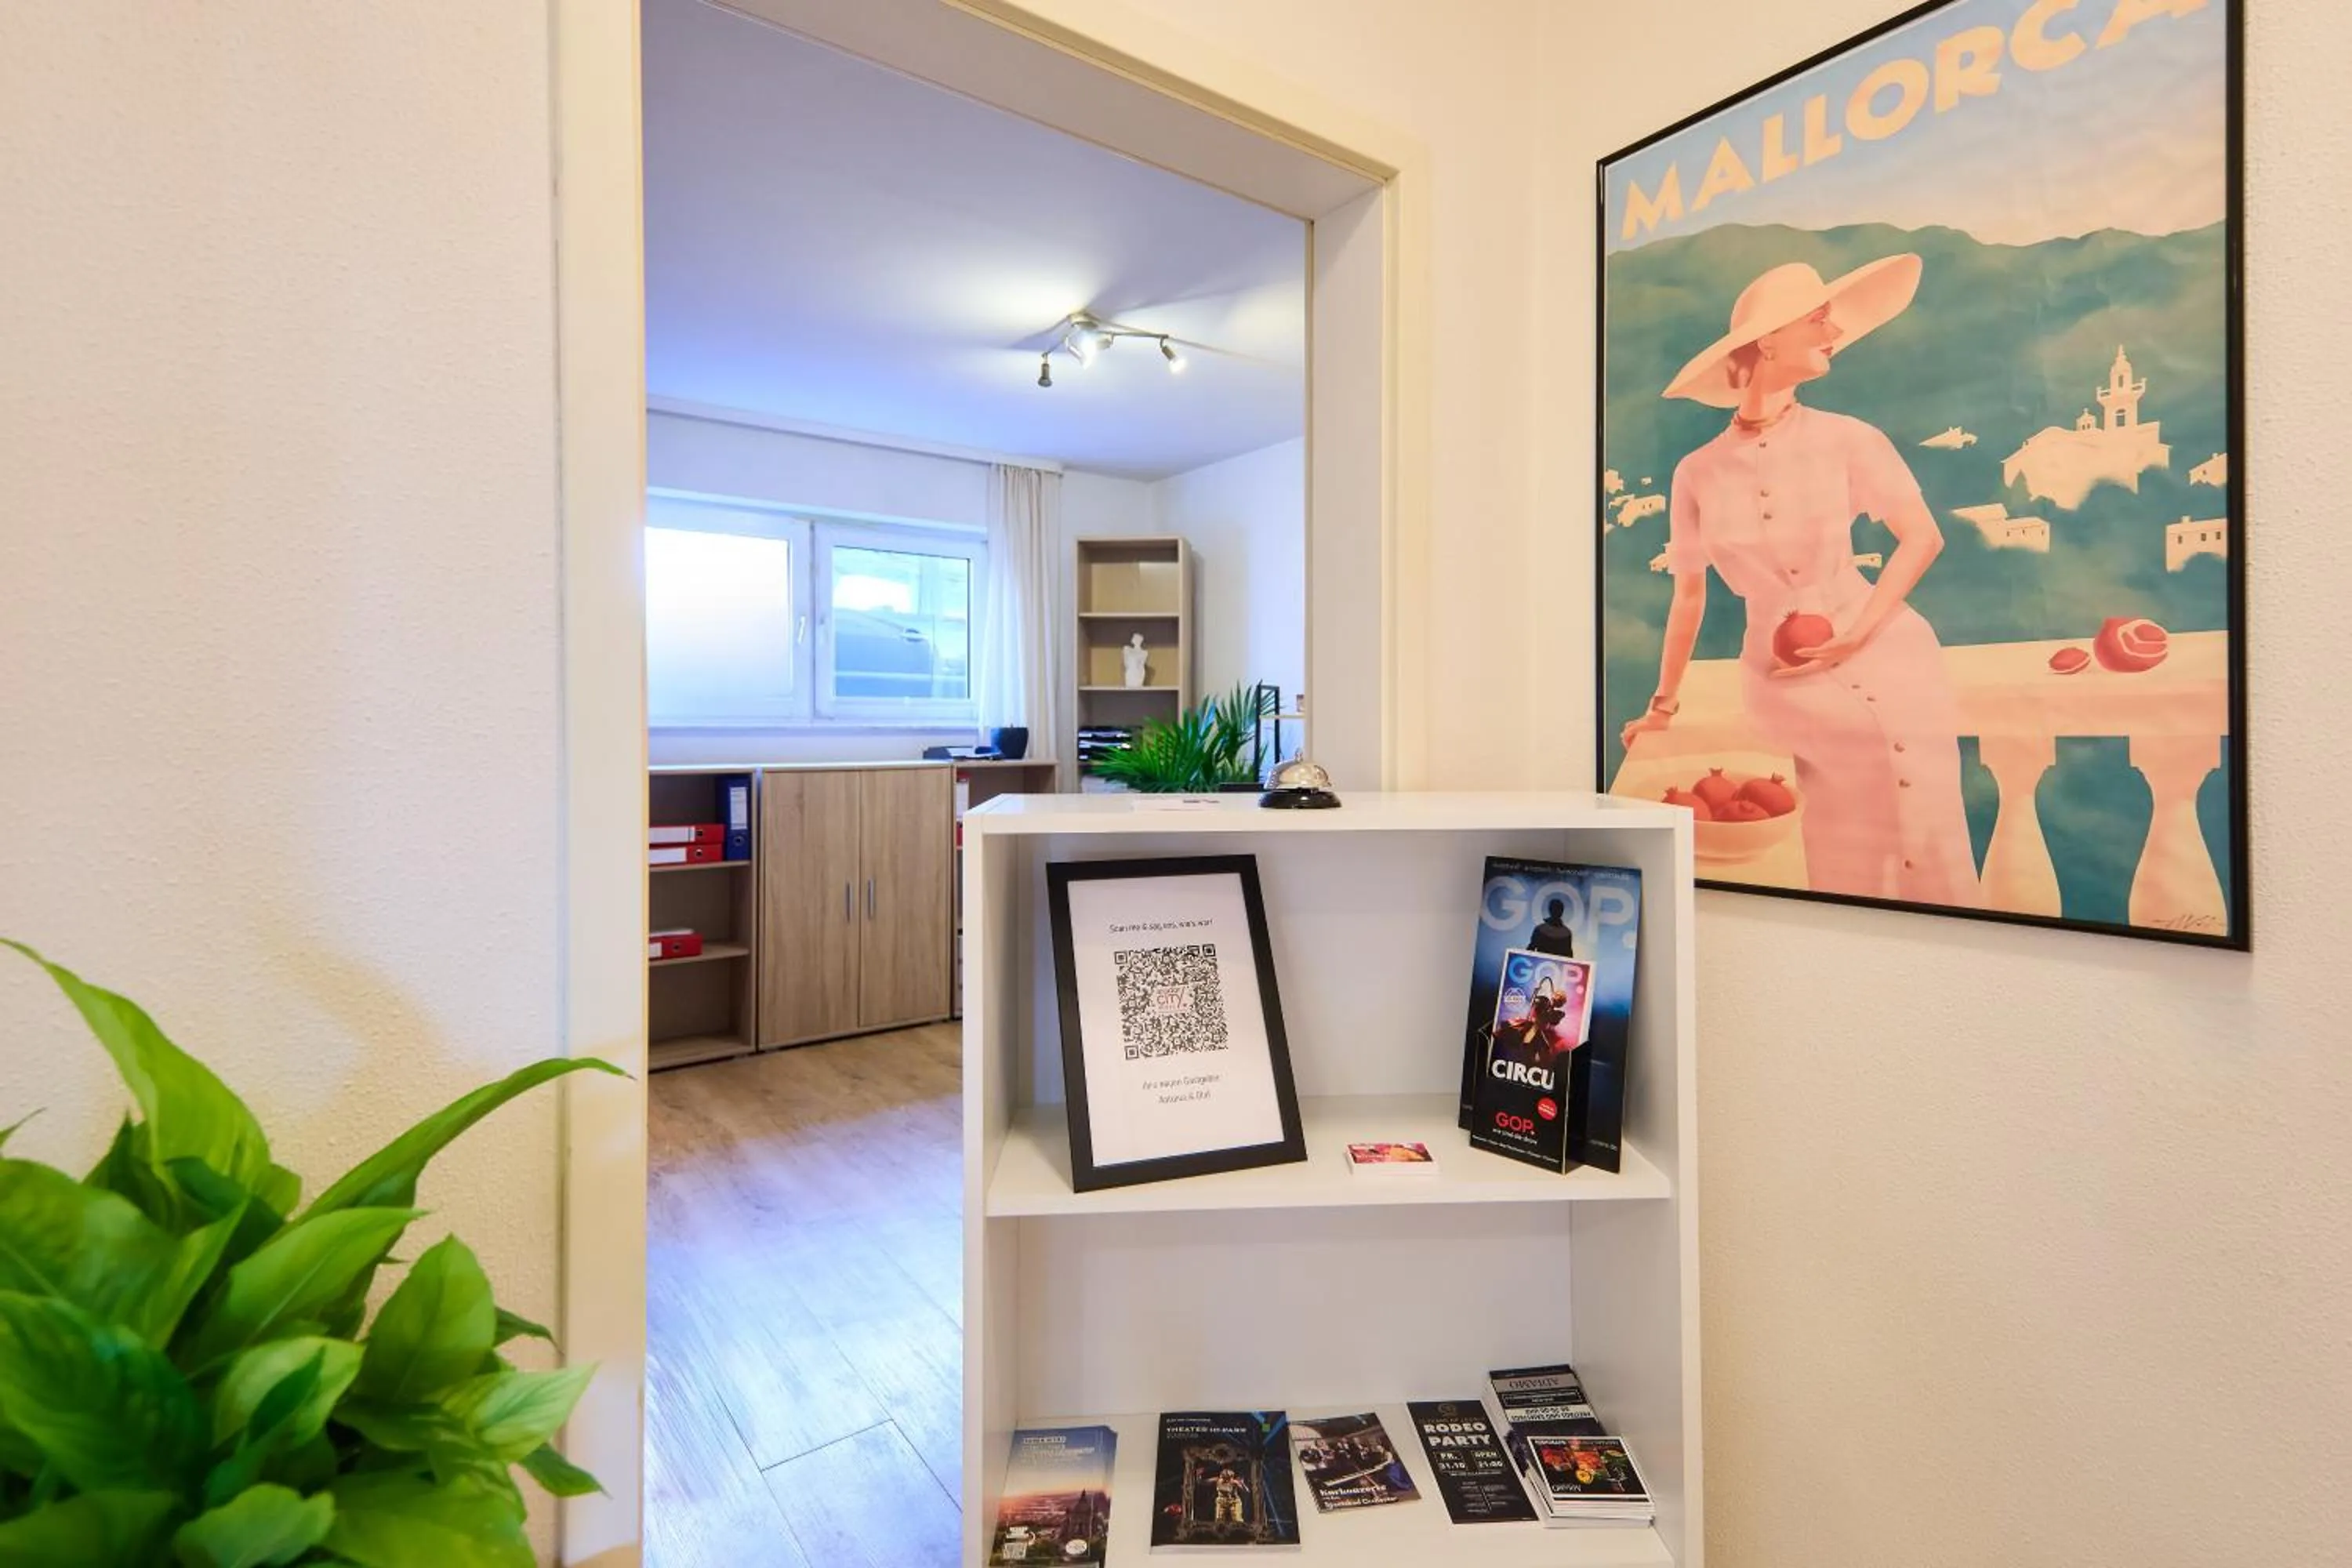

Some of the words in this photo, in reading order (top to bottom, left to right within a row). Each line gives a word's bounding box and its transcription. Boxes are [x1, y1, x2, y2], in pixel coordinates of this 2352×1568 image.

[1492, 1059, 1555, 1091] CIRCU
[1423, 1422, 1486, 1434] RODEO
[1428, 1434, 1490, 1446] PARTY
